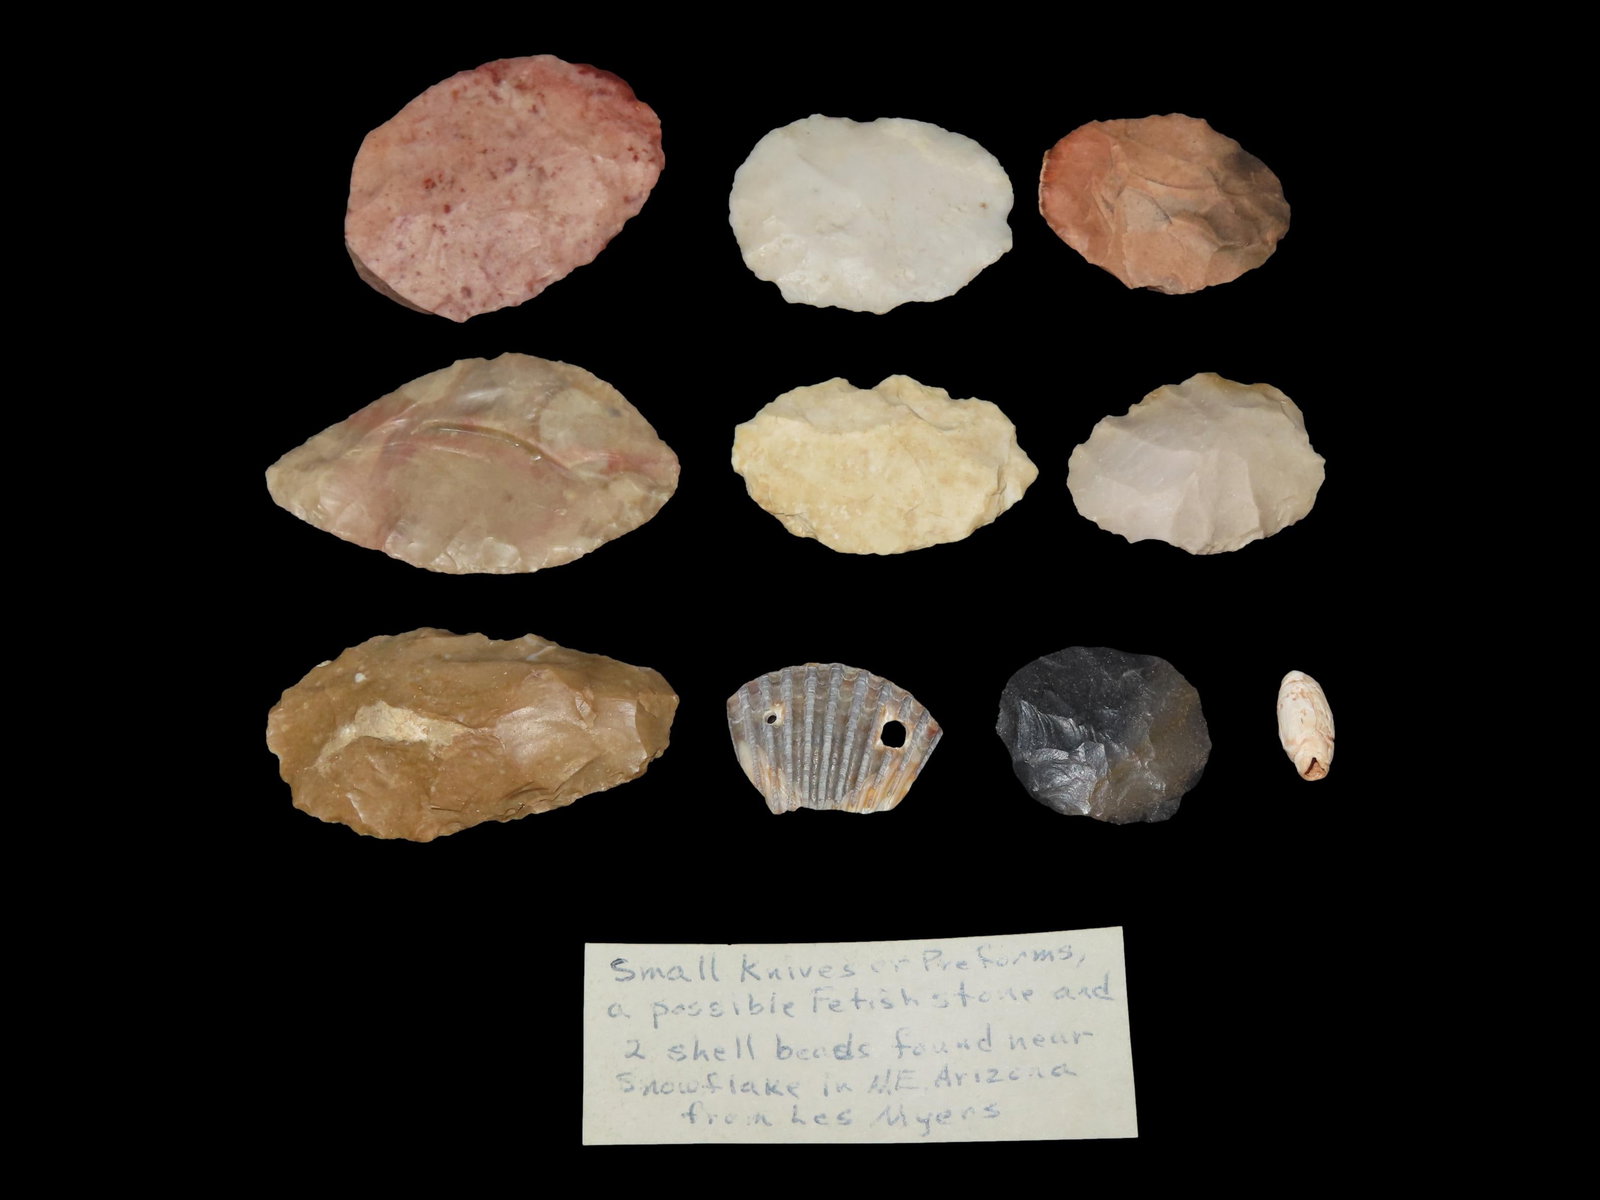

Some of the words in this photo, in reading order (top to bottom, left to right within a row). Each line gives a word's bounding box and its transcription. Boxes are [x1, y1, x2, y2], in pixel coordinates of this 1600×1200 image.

[609, 952, 720, 983] Small
[607, 1003, 631, 1019] a
[652, 992, 795, 1030] possible
[1053, 972, 1115, 1002] and
[624, 1039, 646, 1060] 2
[667, 1033, 755, 1062] shell
[775, 1032, 871, 1060] beads
[895, 1022, 993, 1059] found
[1009, 1031, 1094, 1051] near
[823, 1081, 854, 1098] in
[934, 1063, 1077, 1089] Arizona
[680, 1100, 774, 1127] from
[791, 1104, 853, 1127] Les
[868, 1102, 1002, 1138] Myers
